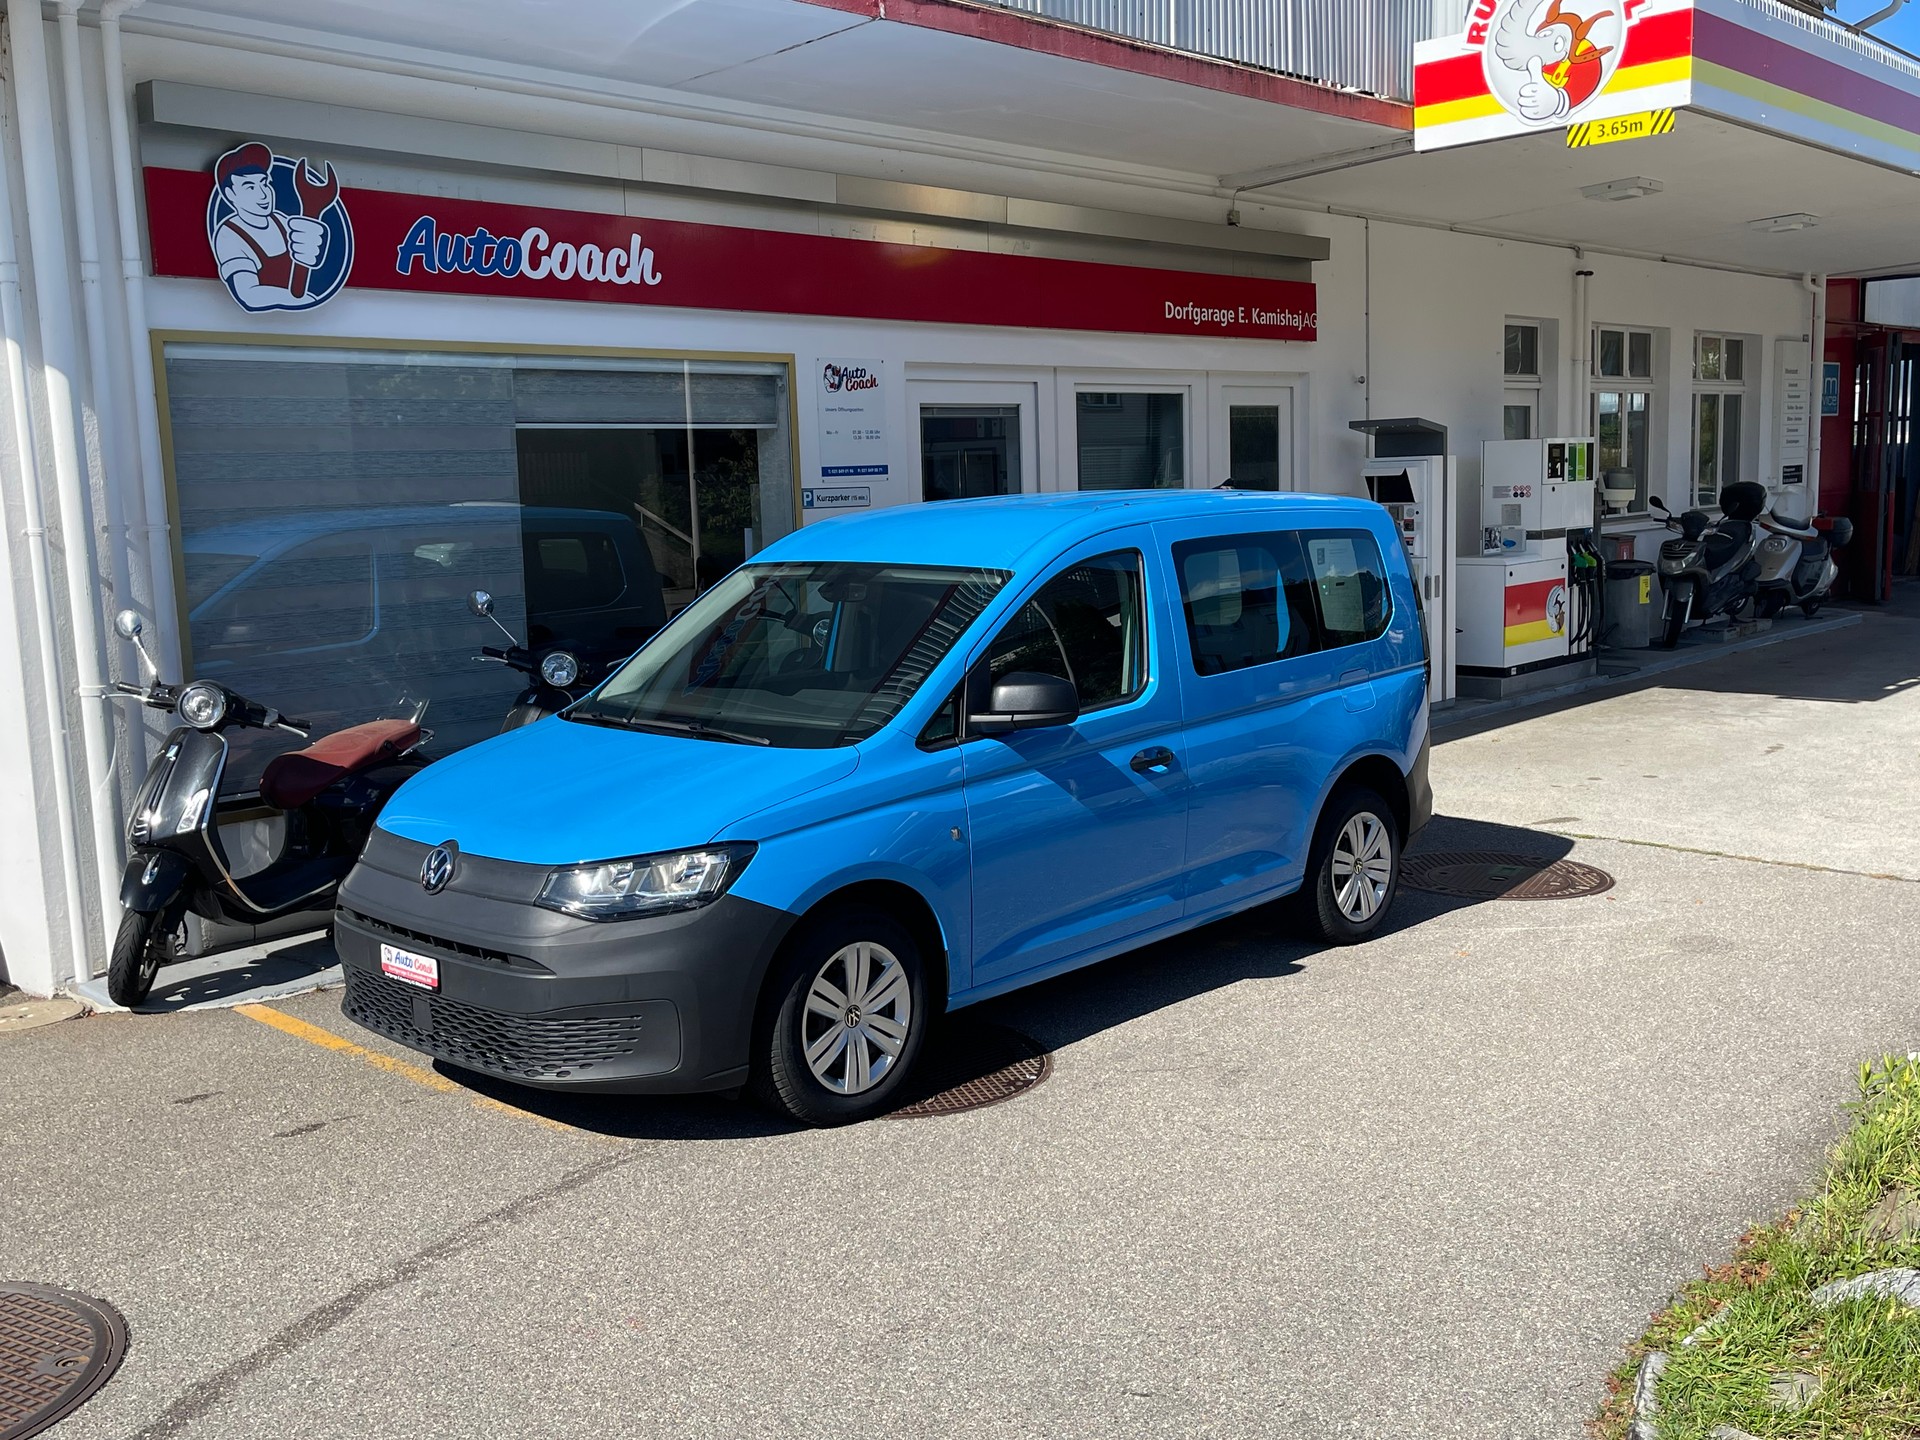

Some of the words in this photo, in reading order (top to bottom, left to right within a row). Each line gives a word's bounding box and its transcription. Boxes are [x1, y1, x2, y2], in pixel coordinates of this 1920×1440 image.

[1596, 120, 1643, 138] 3.65m
[1165, 301, 1235, 327] Dorfgarage
[1238, 307, 1249, 324] E.
[841, 366, 867, 382] Auto
[846, 374, 879, 392] Coach
[803, 491, 813, 506] P
[816, 494, 850, 503] Kurzparker
[394, 951, 413, 969] Auto
